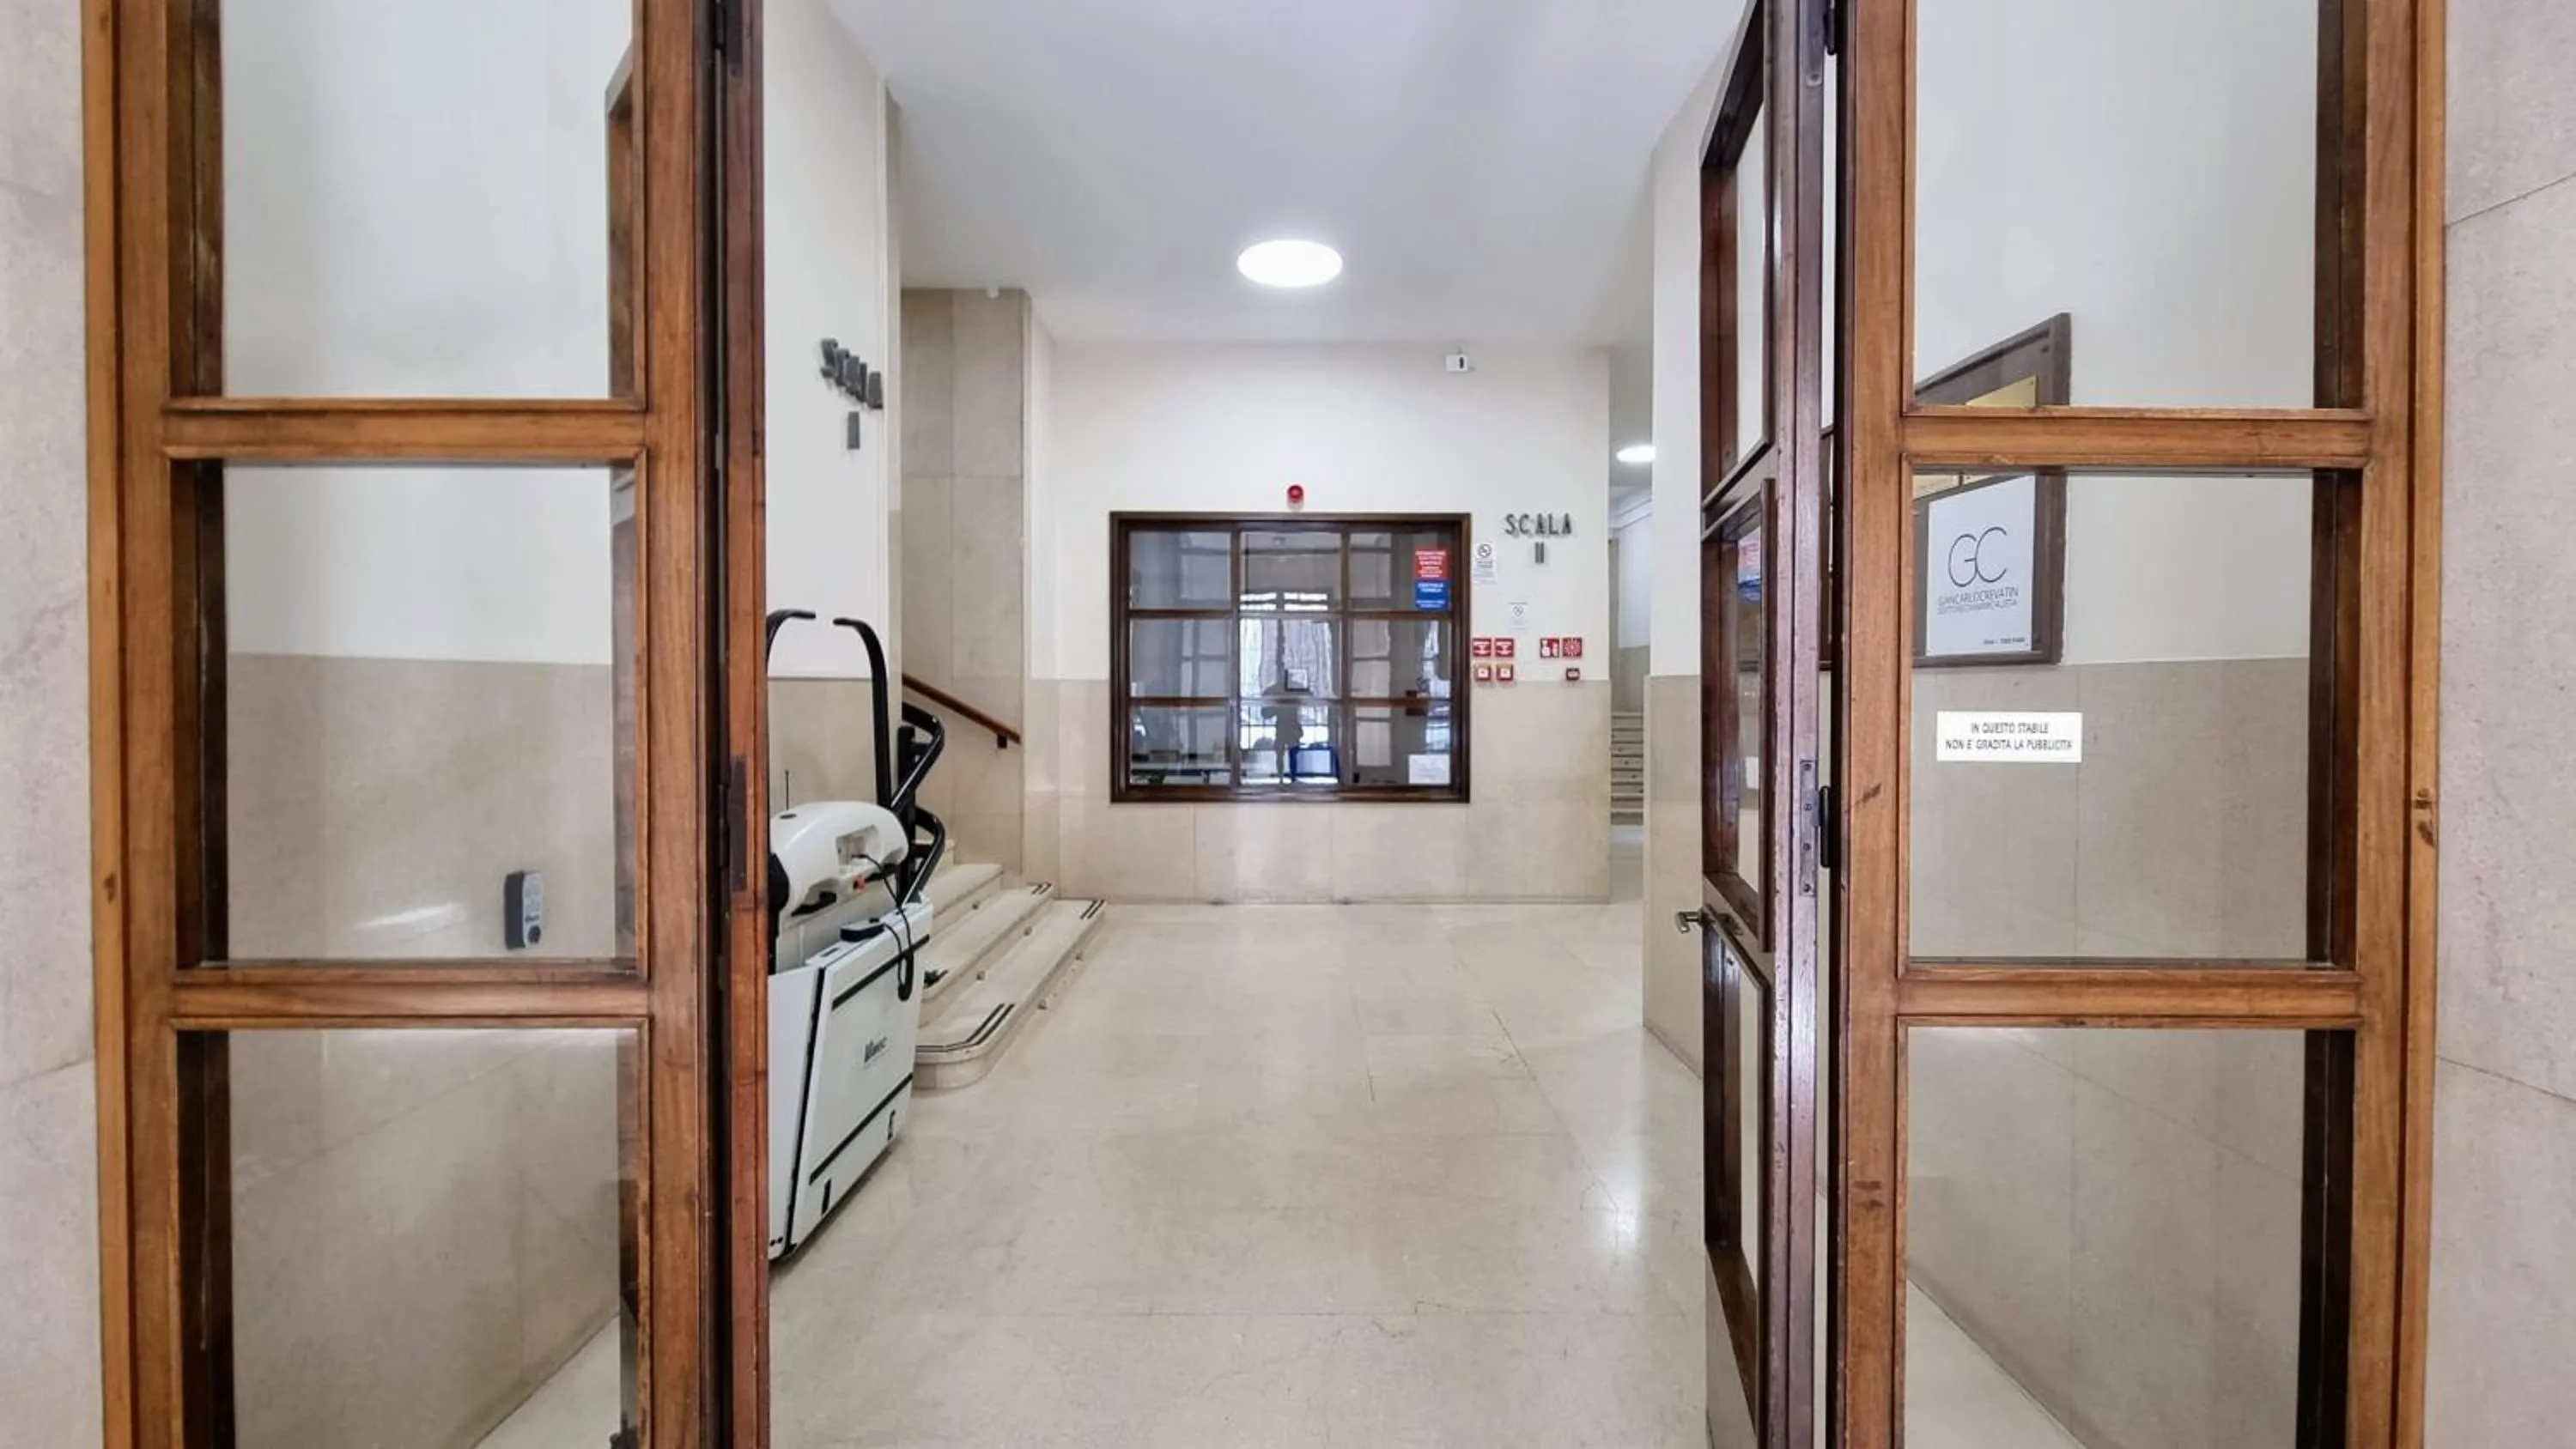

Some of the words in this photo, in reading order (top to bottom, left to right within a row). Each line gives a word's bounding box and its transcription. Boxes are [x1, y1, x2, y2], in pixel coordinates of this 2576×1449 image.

[1504, 512, 1572, 535] SCALA
[1948, 526, 2007, 587] GC
[1971, 722, 1978, 733] IN
[1982, 722, 2014, 734] QUESTO
[2017, 722, 2049, 734] STABILE
[1945, 739, 1964, 749] NON
[1976, 739, 2011, 749] GRADITA
[2014, 739, 2023, 749] LA
